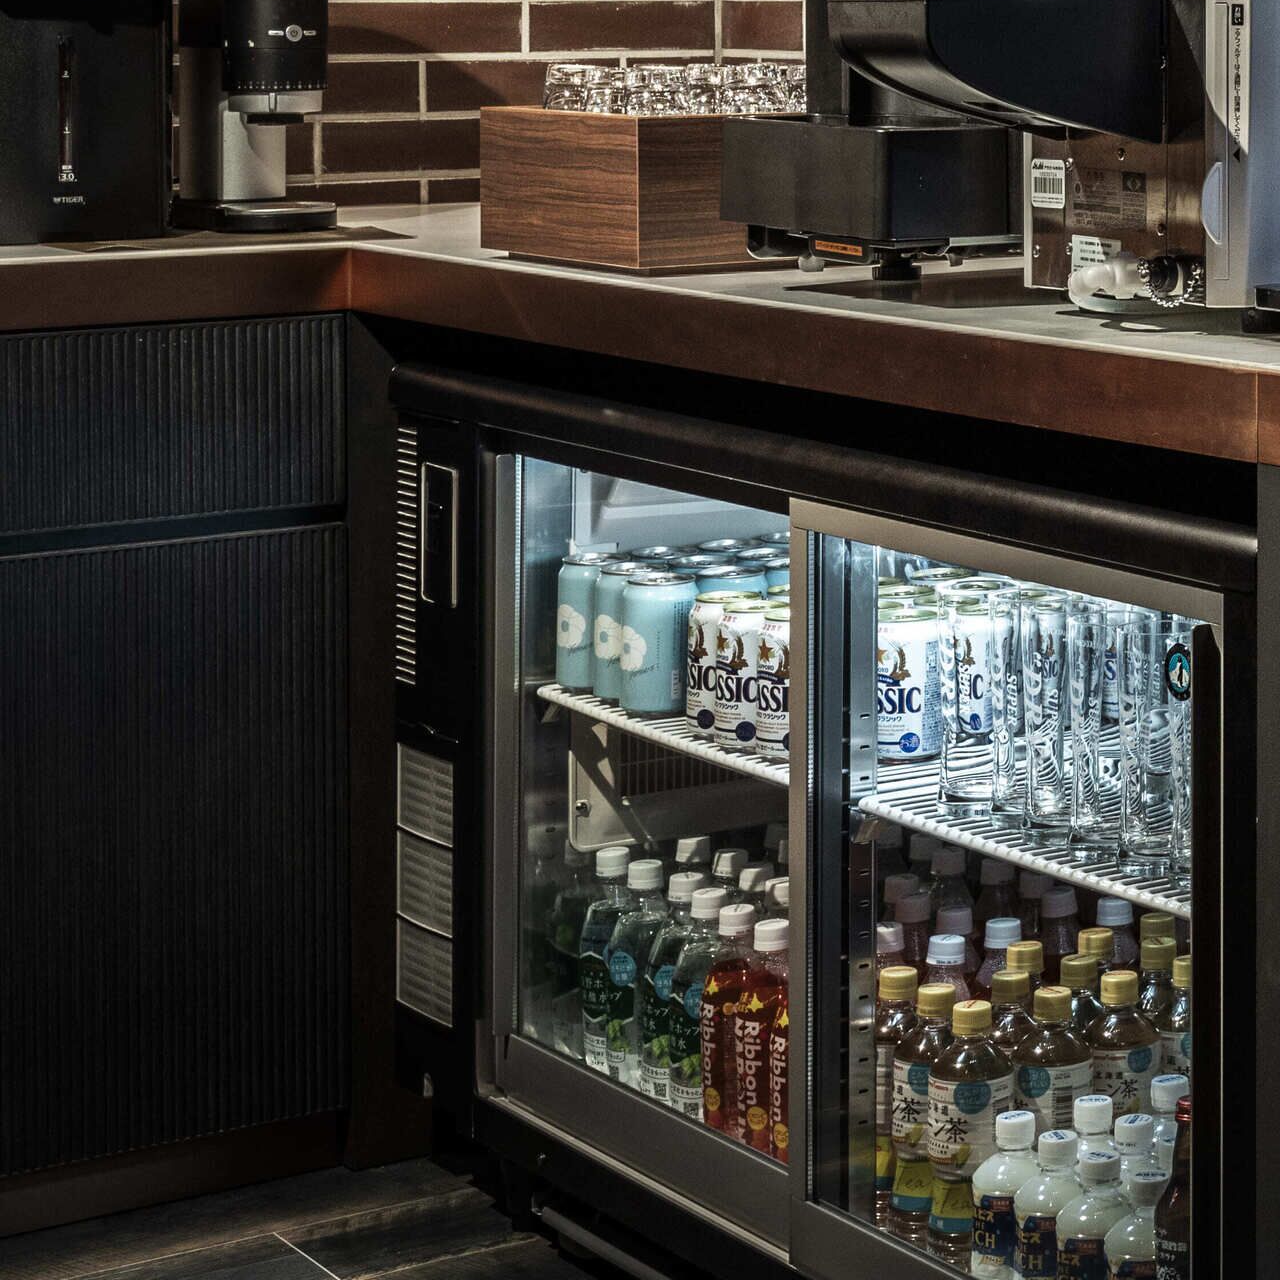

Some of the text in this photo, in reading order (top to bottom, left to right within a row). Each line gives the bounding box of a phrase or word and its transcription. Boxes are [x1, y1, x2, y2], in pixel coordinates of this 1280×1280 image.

[1006, 672, 1018, 726] SUPER
[702, 1001, 718, 1086] Ribbon
[743, 1020, 761, 1106] Ribbon
[772, 1034, 788, 1122] Ribbon
